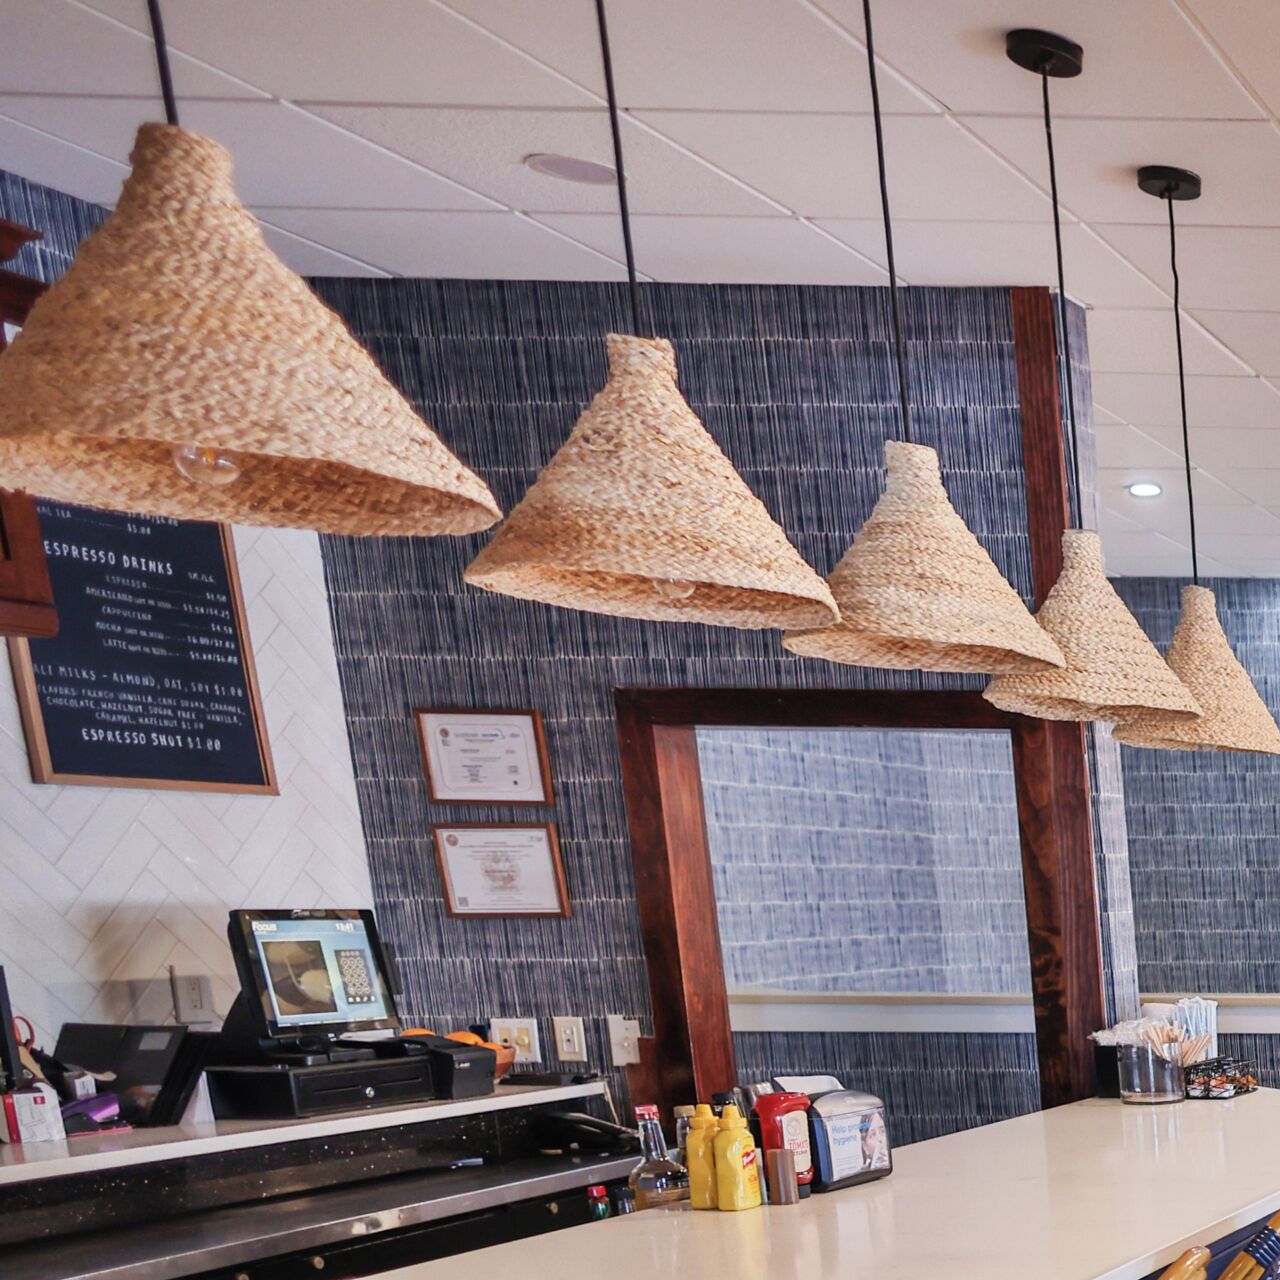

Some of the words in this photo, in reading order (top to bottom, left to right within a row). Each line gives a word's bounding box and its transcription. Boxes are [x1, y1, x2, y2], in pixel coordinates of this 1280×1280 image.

[43, 540, 116, 565] ESPRESSO
[122, 554, 173, 576] DRINKS
[105, 574, 148, 590] ESPRESSO
[102, 638, 127, 651] LATTE
[59, 665, 96, 681] MILKS
[112, 671, 160, 690] ALMOND,
[191, 682, 210, 694] SOY
[81, 728, 147, 745] ESPRESSO
[151, 732, 183, 748] SHOT
[187, 736, 222, 751] $1.00
